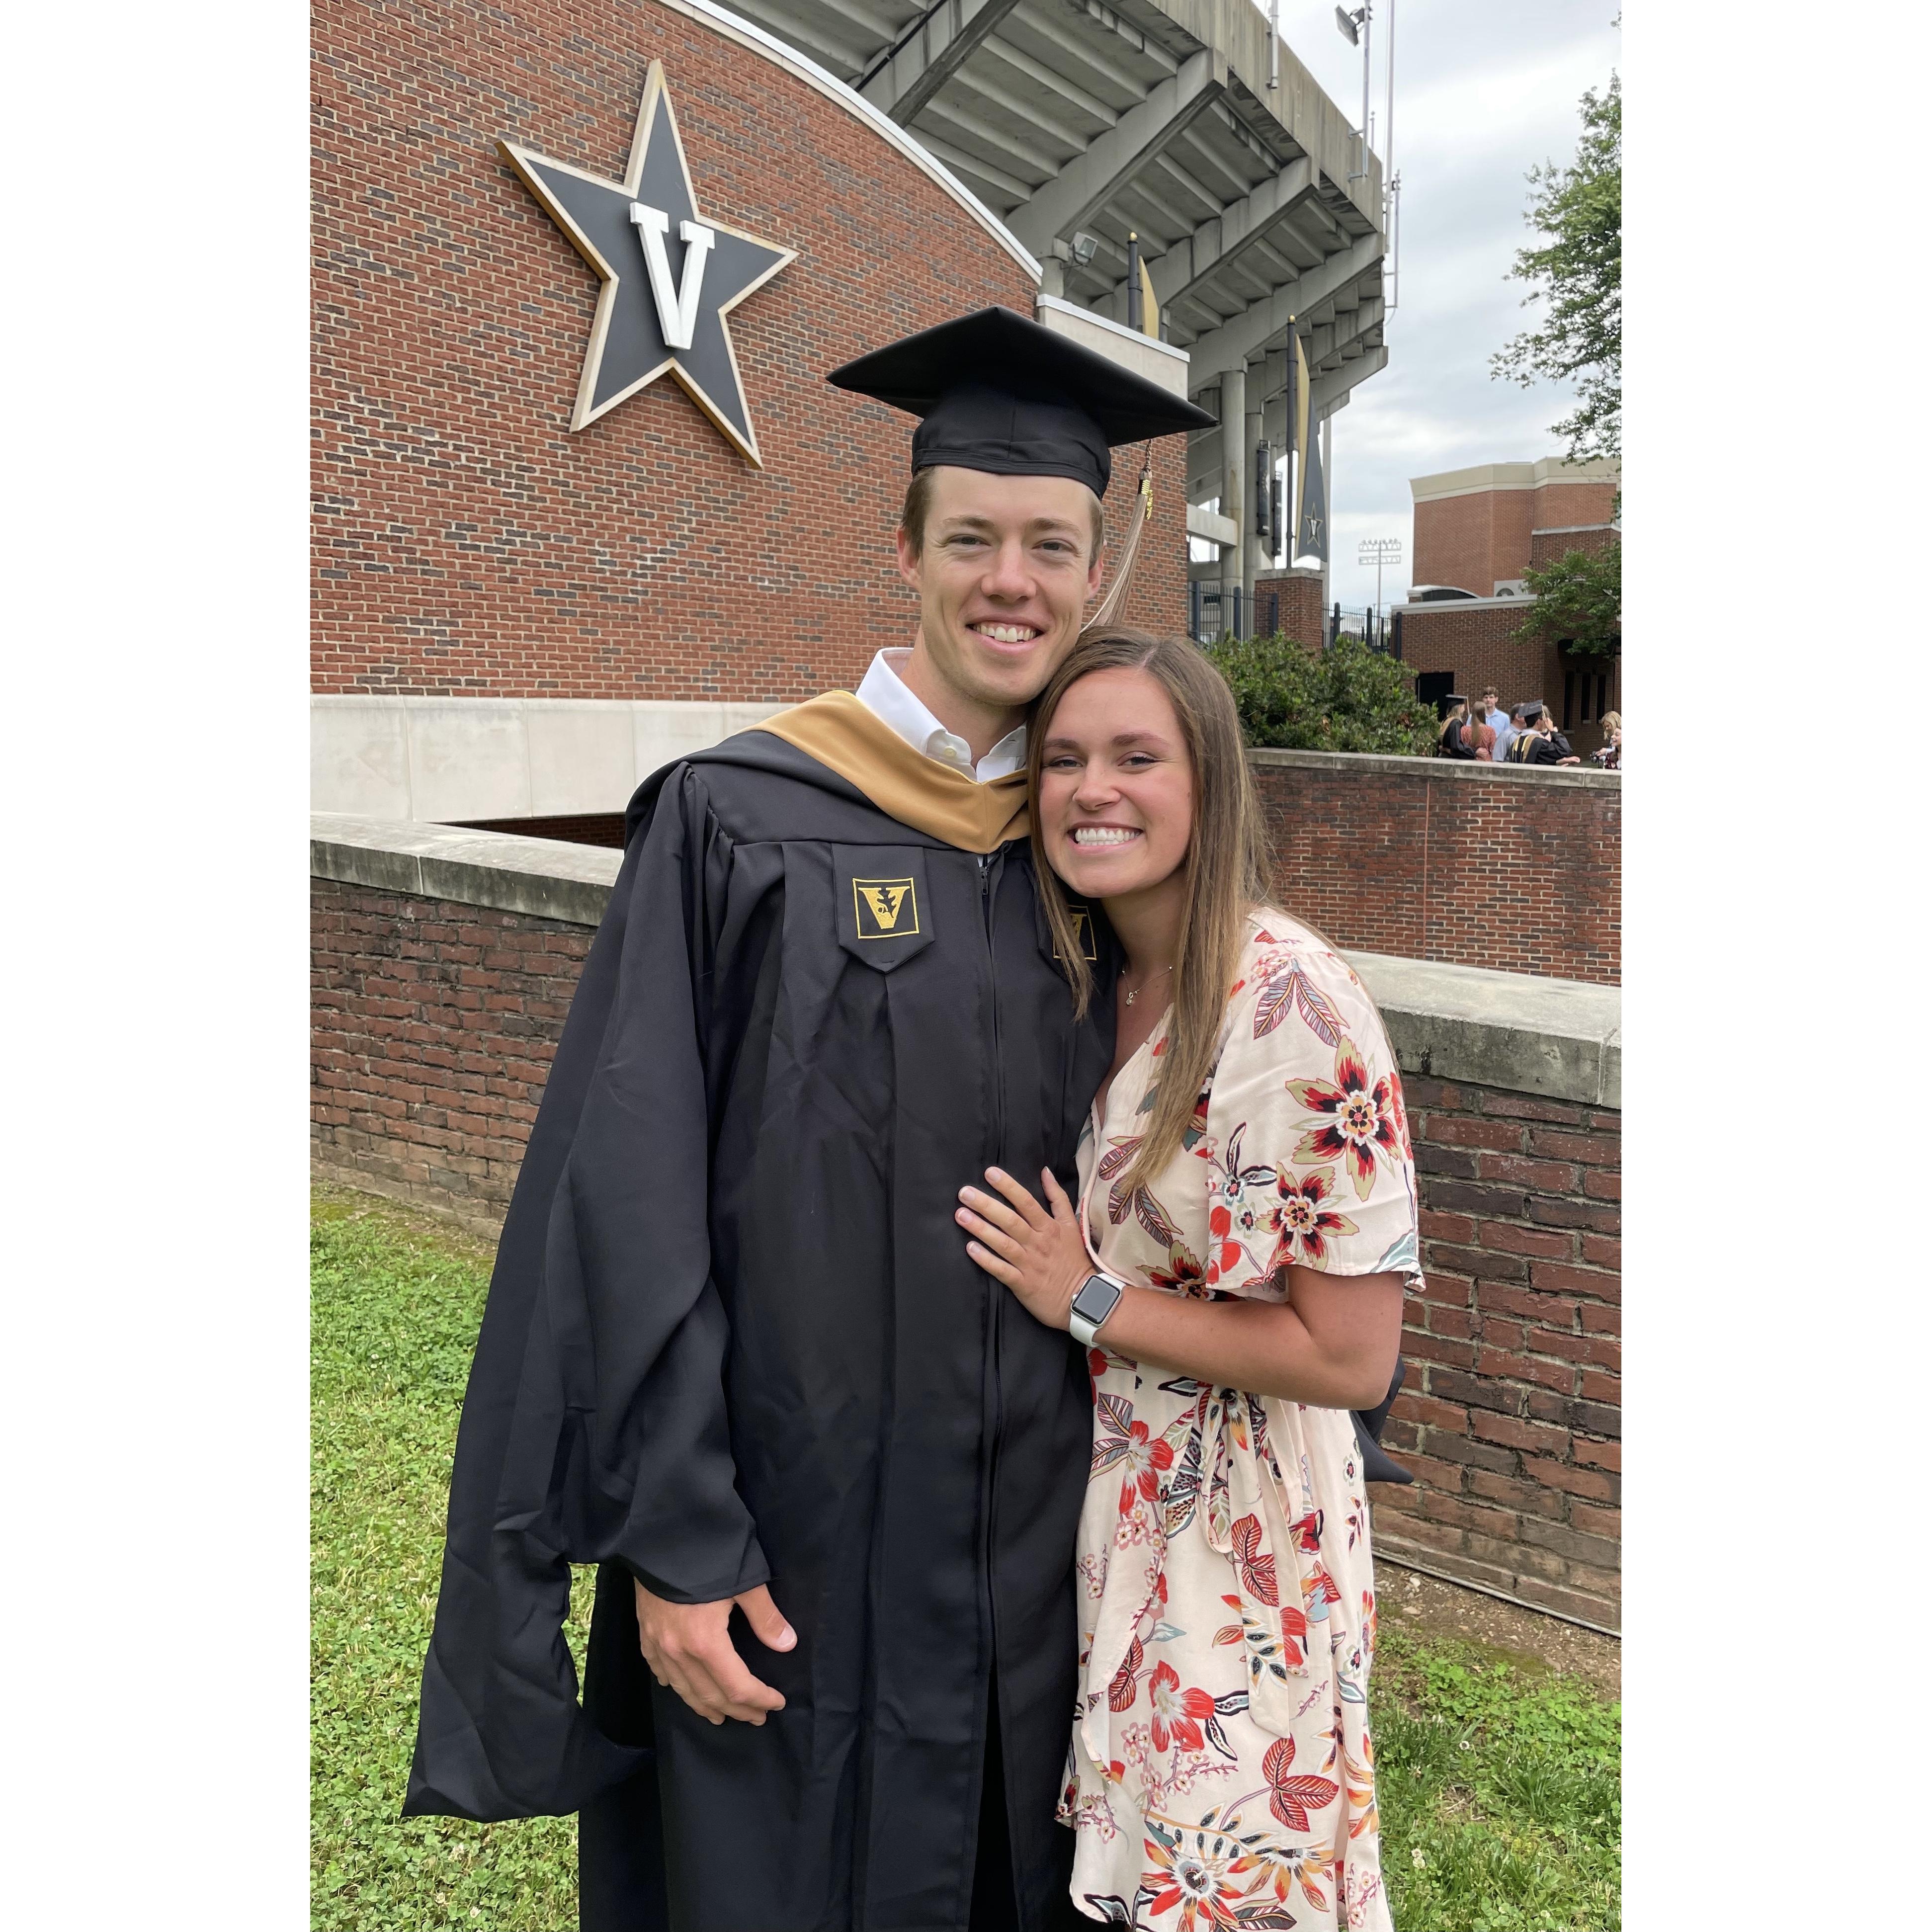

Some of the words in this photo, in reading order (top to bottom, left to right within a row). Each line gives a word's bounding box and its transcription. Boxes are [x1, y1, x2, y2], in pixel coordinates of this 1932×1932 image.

[629, 201, 715, 350] V
[1310, 519, 1317, 536] V
[858, 886, 910, 929] V
